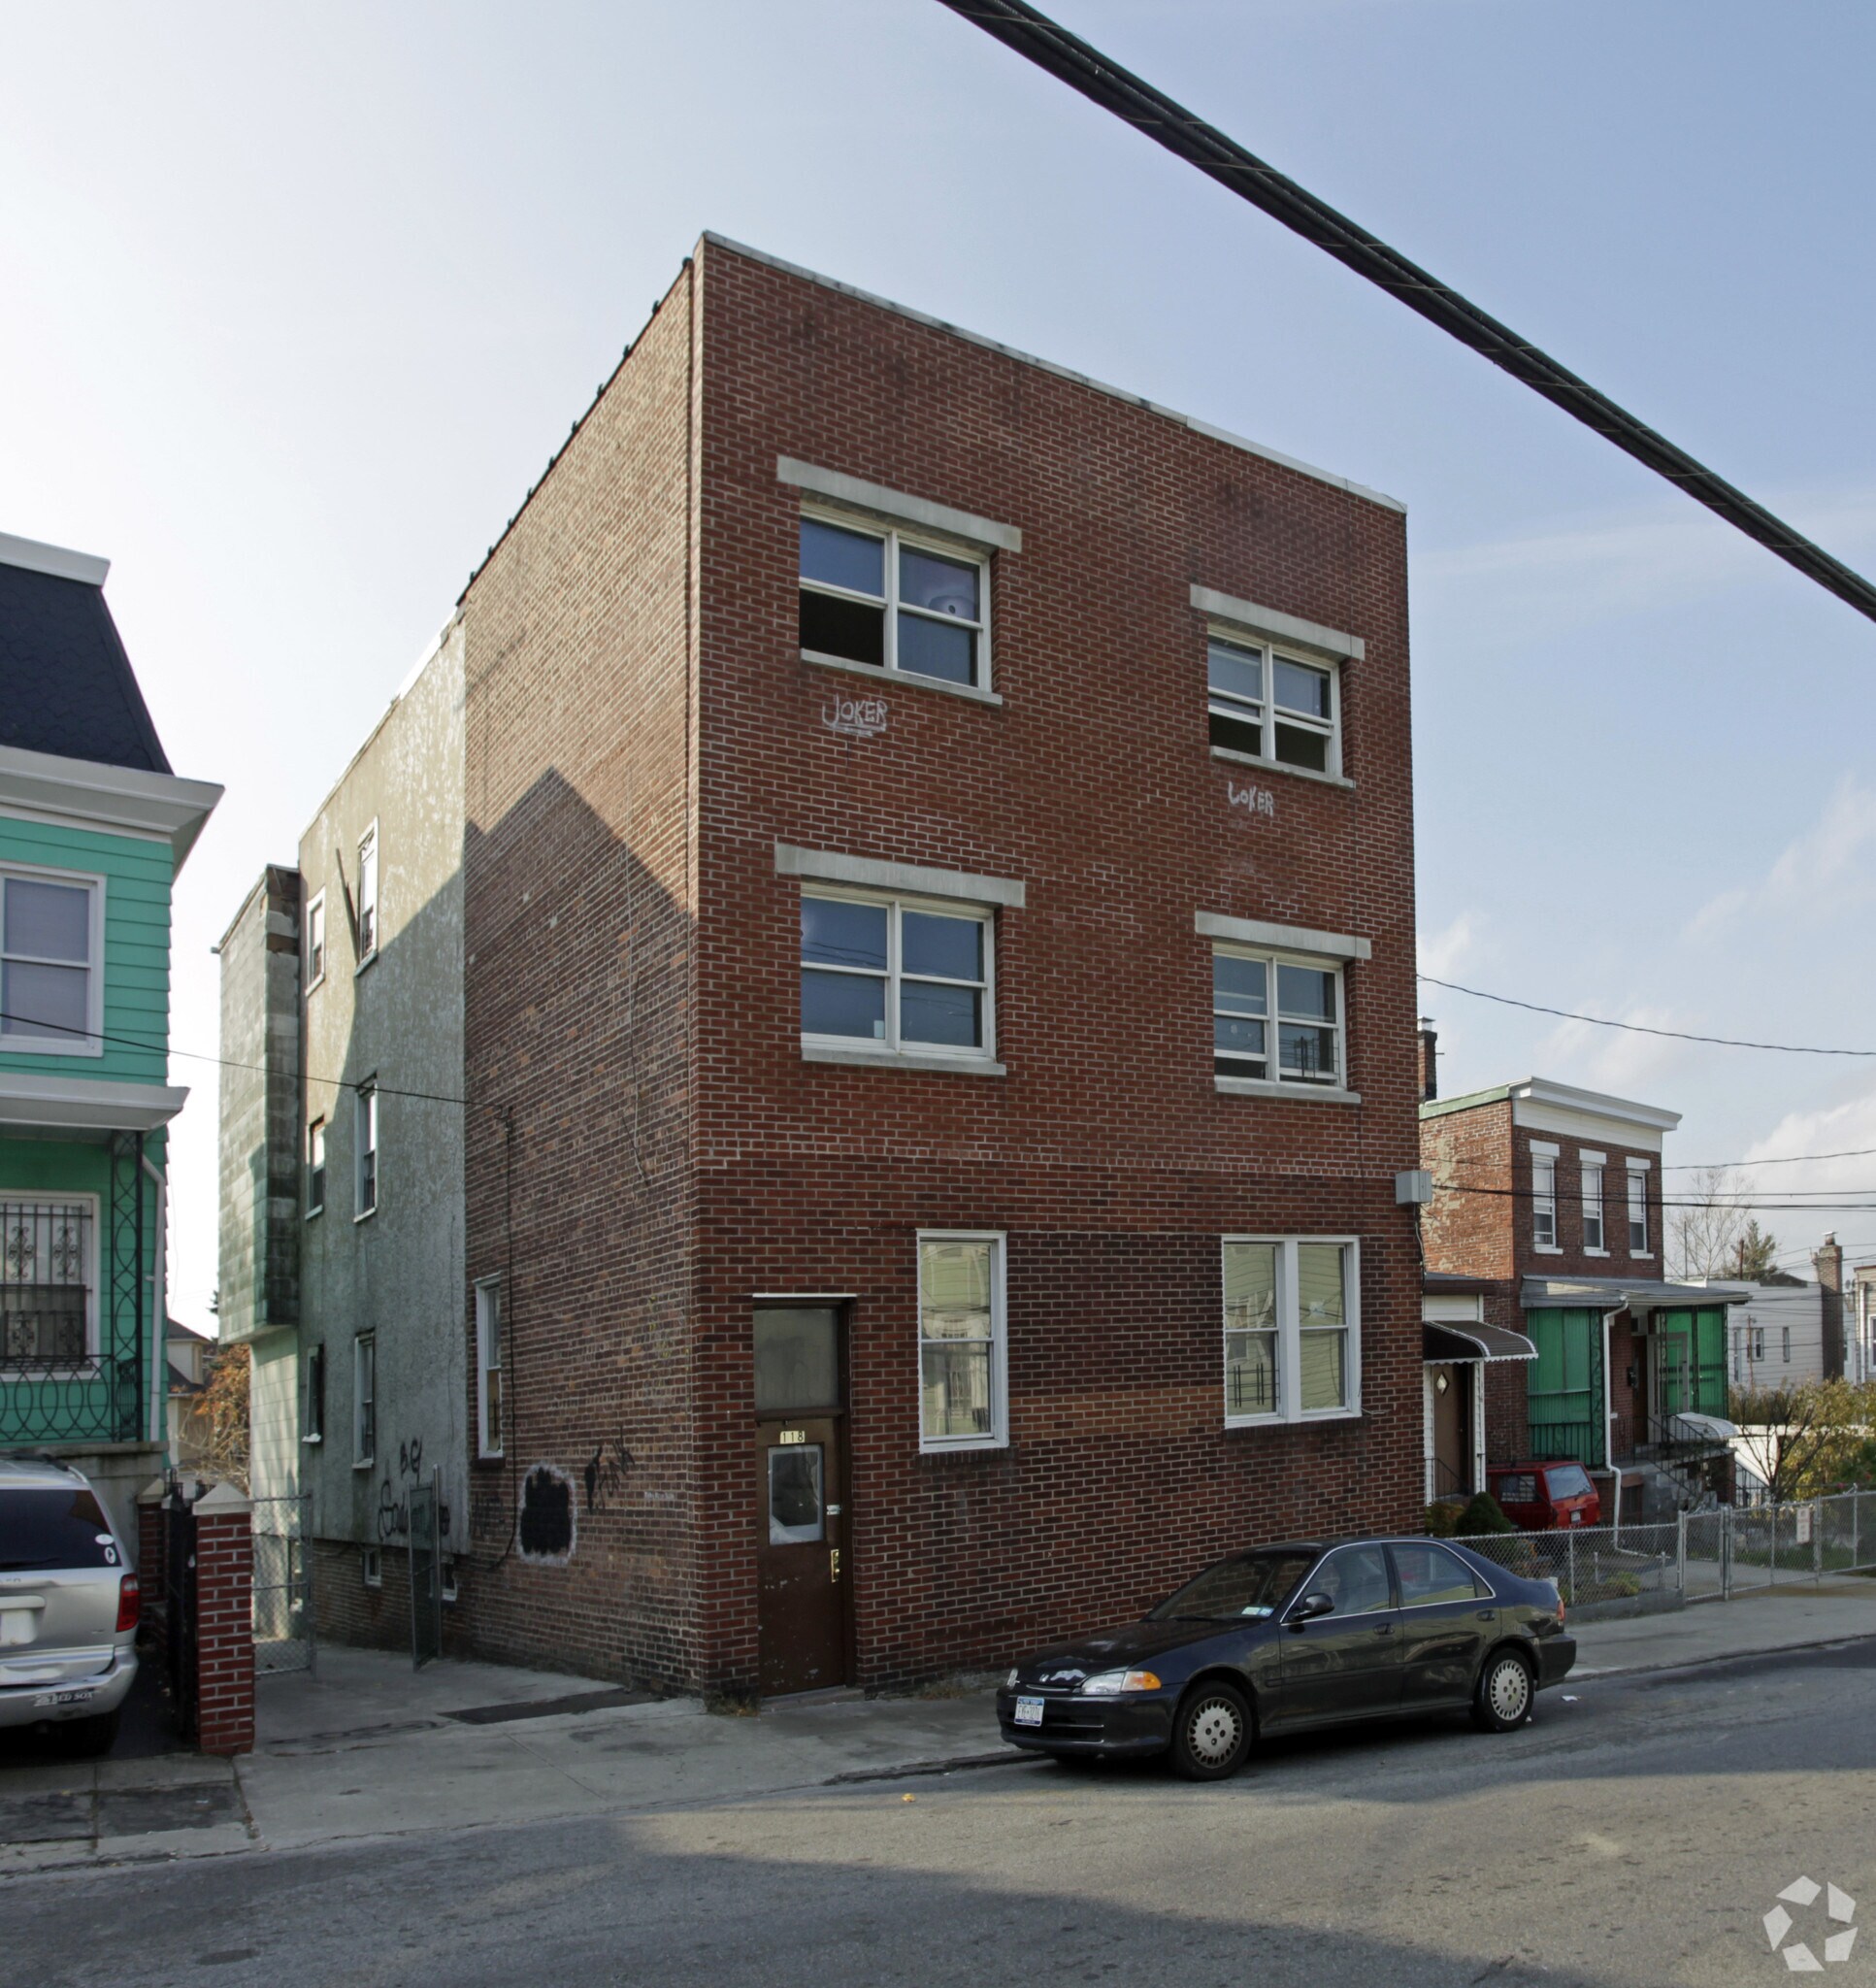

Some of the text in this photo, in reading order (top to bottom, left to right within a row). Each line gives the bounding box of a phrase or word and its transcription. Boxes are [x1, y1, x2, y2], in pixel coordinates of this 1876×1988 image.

[822, 693, 888, 732] JOKER
[782, 1432, 804, 1442] 118
[74, 1691, 94, 1701] SOX
